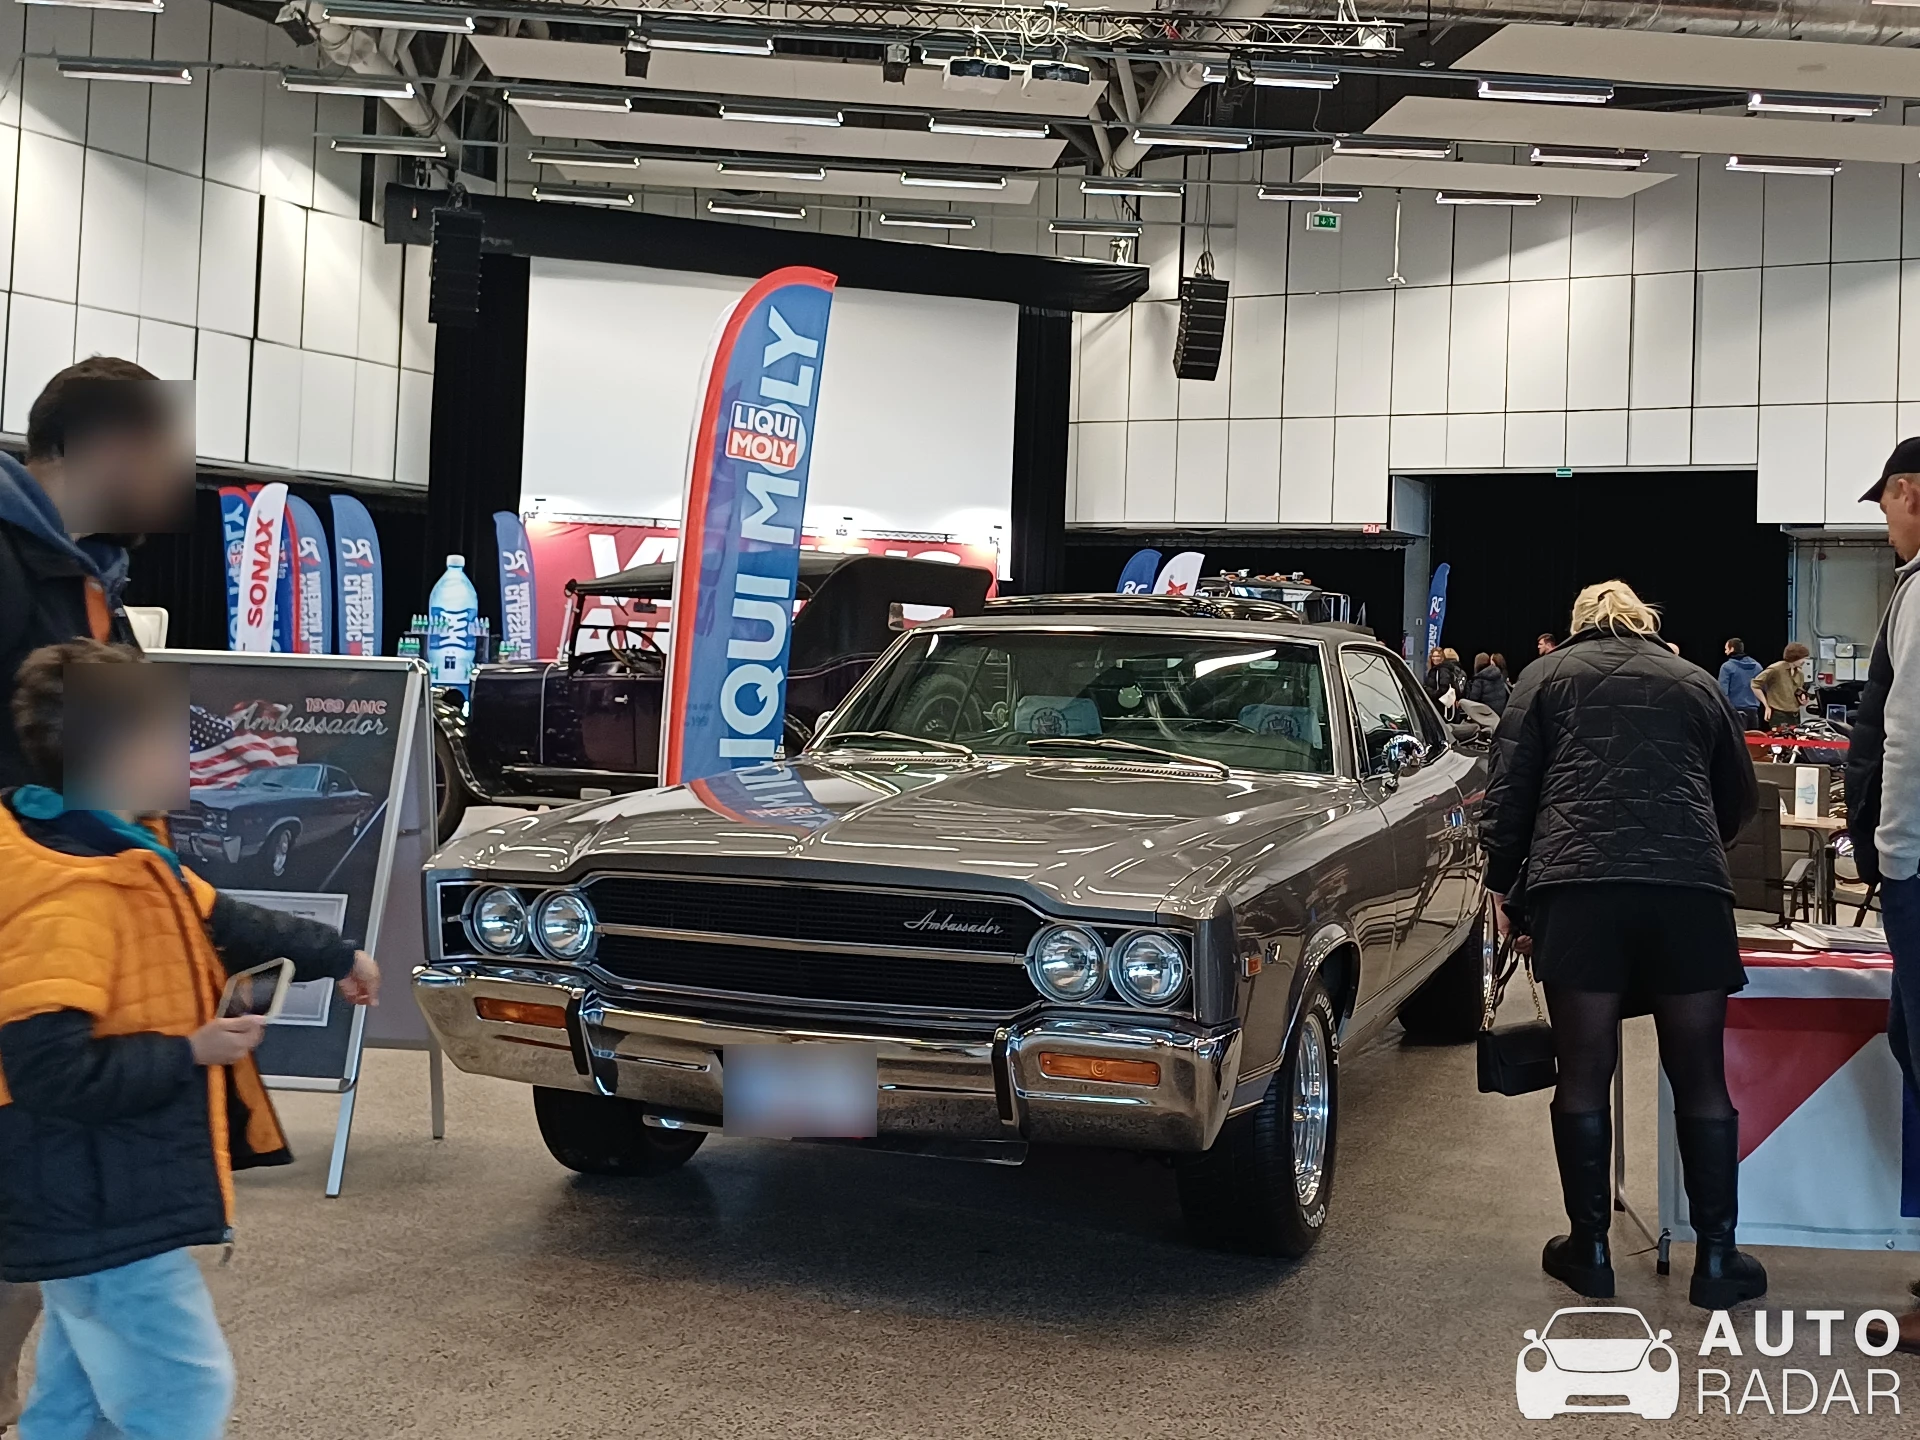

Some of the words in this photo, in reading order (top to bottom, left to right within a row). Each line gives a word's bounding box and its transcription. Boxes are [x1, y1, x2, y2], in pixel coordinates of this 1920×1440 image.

[734, 405, 797, 440] LIQUI
[731, 431, 796, 465] MOLY
[247, 516, 274, 628] SONAX
[233, 700, 388, 735] Ambassador
[346, 700, 388, 715] AMC
[903, 909, 1004, 935] Ambassador
